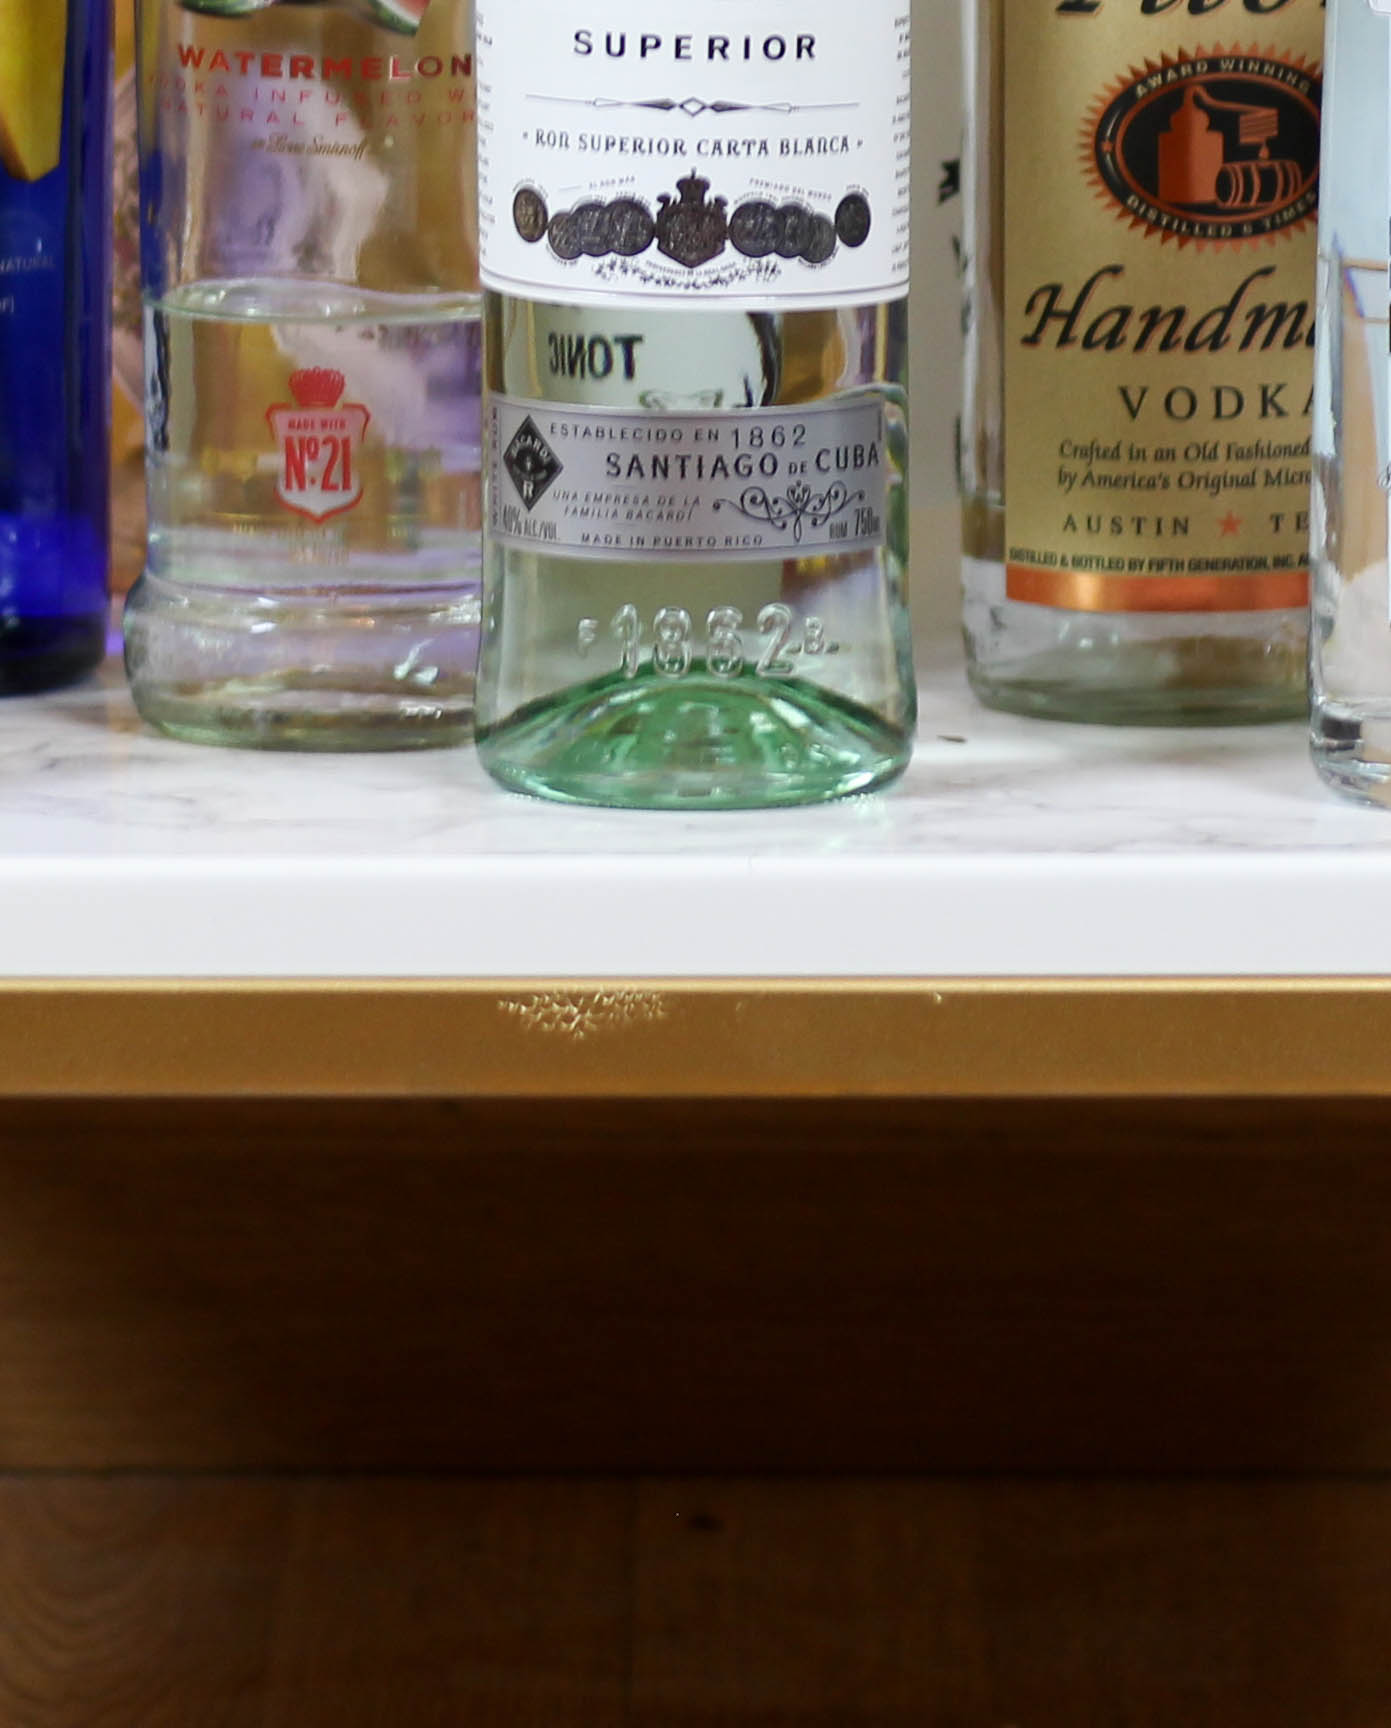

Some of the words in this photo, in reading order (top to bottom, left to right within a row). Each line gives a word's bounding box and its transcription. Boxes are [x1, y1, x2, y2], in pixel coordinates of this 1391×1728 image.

[572, 29, 818, 62] SUPERIOR
[177, 42, 474, 82] WATERMELON
[1134, 59, 1209, 99] AWARD
[1219, 57, 1311, 94] WINNING
[335, 111, 475, 126] FLAVOR
[578, 133, 687, 157] SUPERIOR
[696, 138, 770, 157] CARTA
[1125, 193, 1233, 239] DISTILLED
[550, 421, 684, 443] ESTABLECIDO
[694, 426, 720, 444] EN
[731, 422, 809, 450] 1862
[605, 451, 780, 481] SANTIAGO
[788, 459, 808, 475] DE
[814, 440, 880, 473] CUBA
[1059, 438, 1121, 466] Crafted
[1128, 440, 1148, 463] in
[1153, 445, 1176, 463] an
[1183, 440, 1220, 463] Old
[1057, 468, 1077, 491] by
[1081, 468, 1171, 491] America's
[1177, 470, 1258, 497] Original
[563, 504, 620, 521] FAMILIA
[580, 490, 653, 507] EMPRESA
[656, 494, 677, 508] DE
[1062, 513, 1192, 536] AUSTIN
[724, 533, 765, 547] RICO
[1071, 554, 1126, 571] BOTTLED
[1128, 556, 1146, 572] BY
